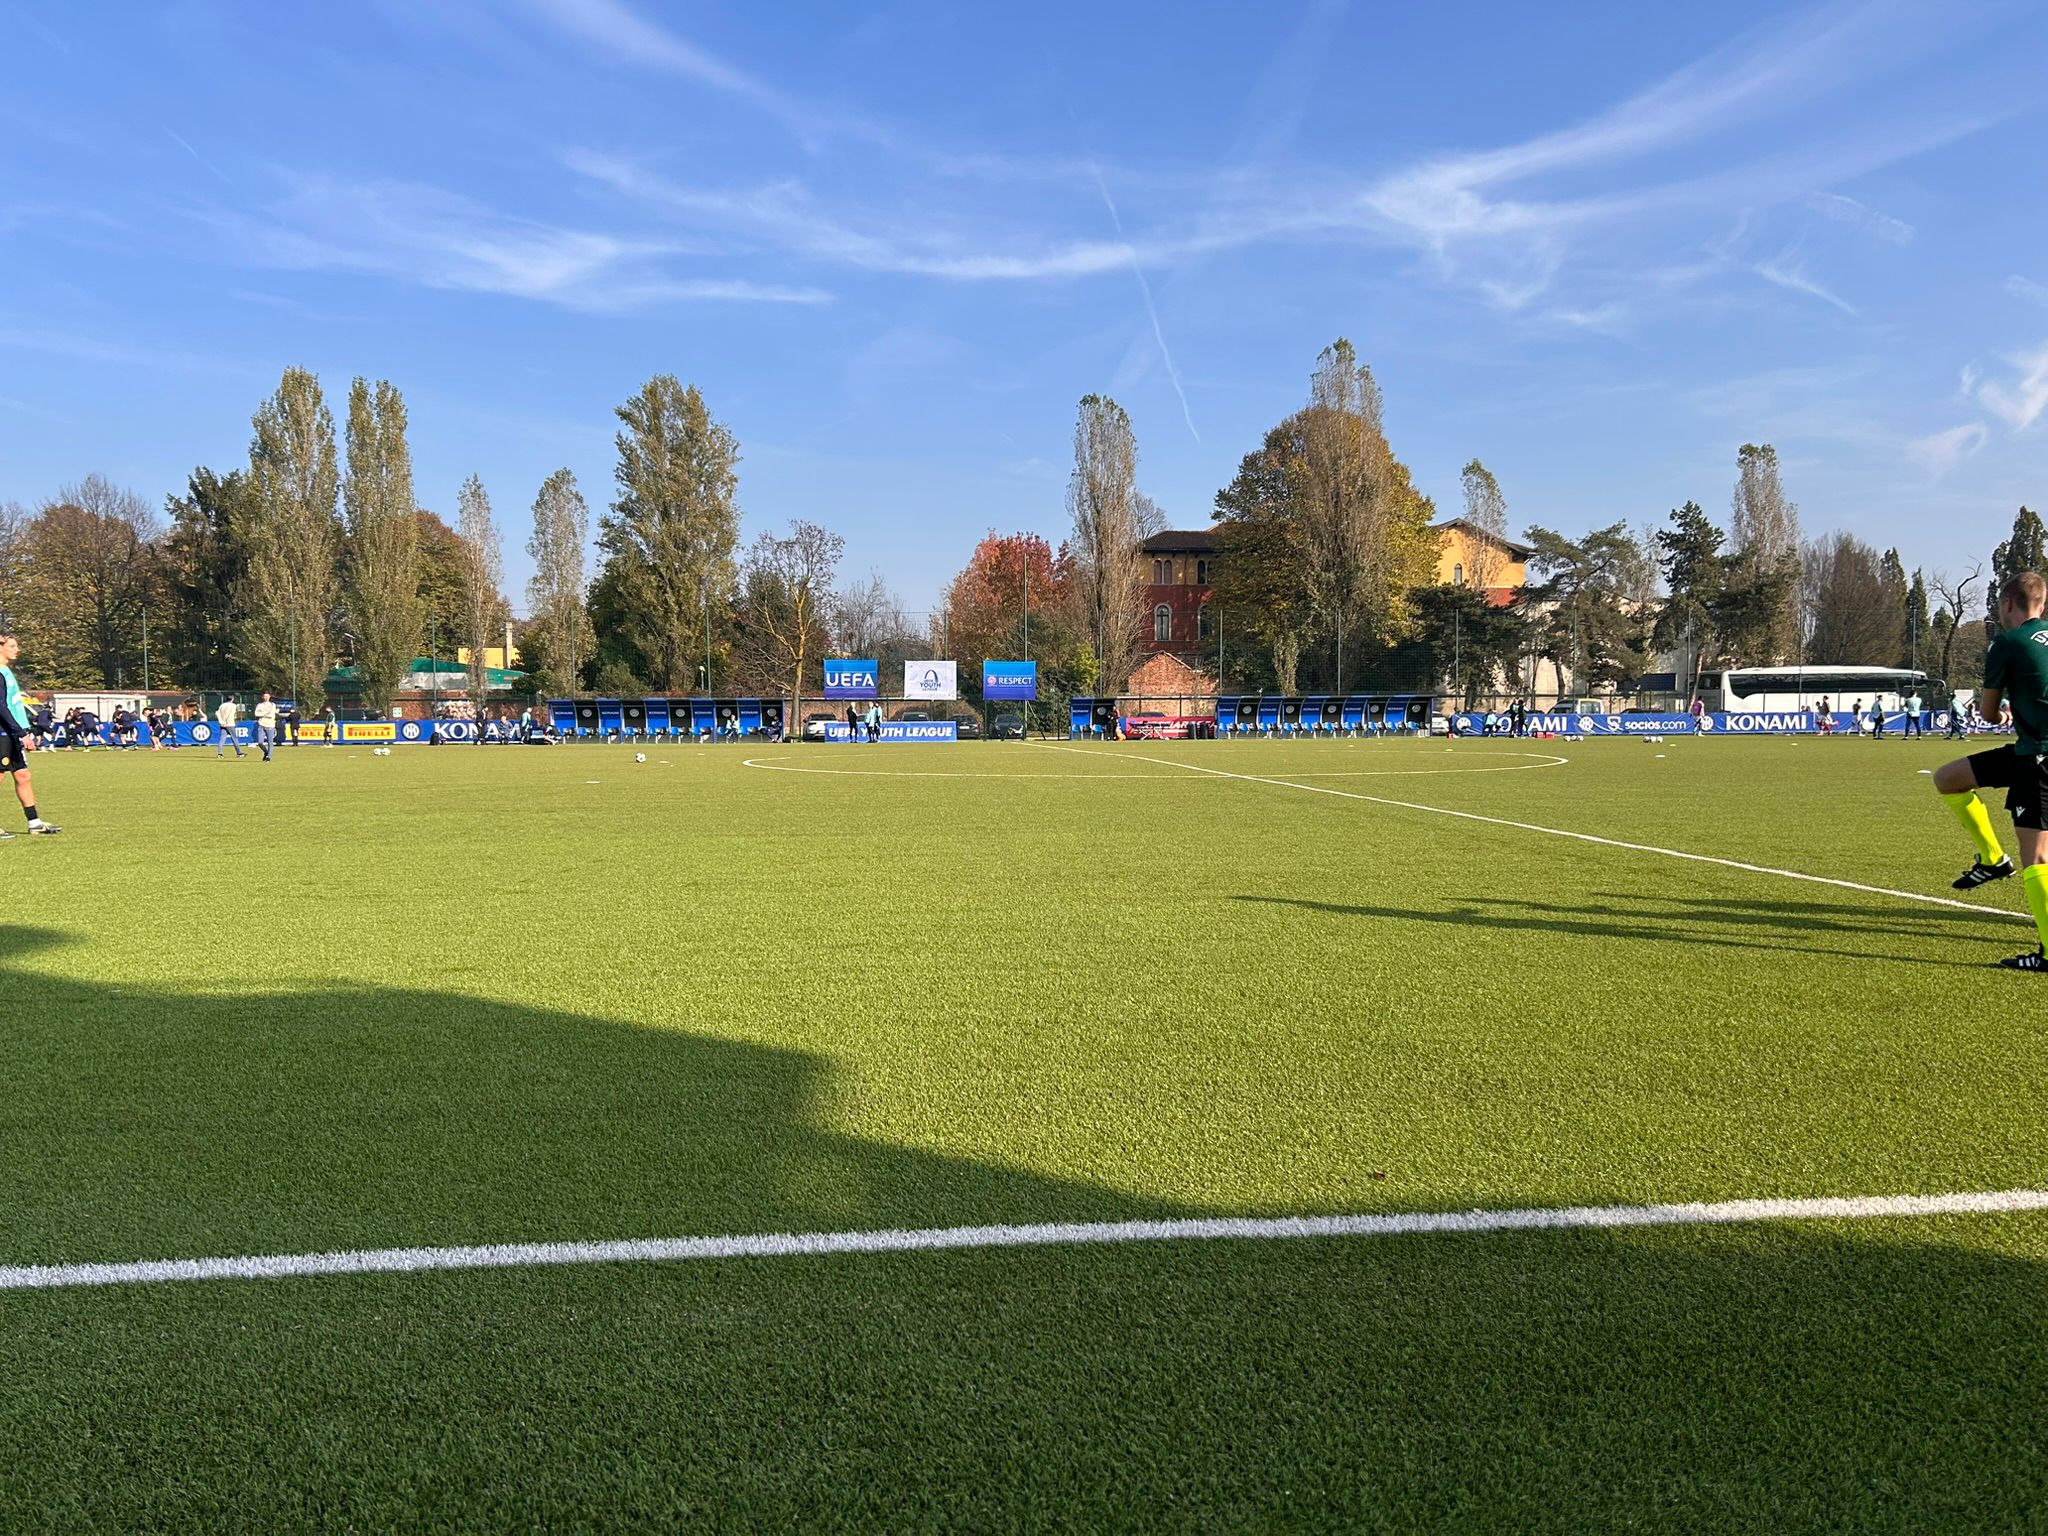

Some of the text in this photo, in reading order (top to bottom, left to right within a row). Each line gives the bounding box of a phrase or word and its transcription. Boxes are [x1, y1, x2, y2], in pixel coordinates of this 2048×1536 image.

[826, 672, 875, 687] UEFA
[998, 677, 1033, 685] RESPECT
[1624, 720, 1687, 730] socios.com
[1725, 714, 1807, 731] KONAMI
[348, 726, 391, 737] PIRELLI
[860, 727, 903, 738] YUTH
[905, 726, 953, 737] LEAGUE
